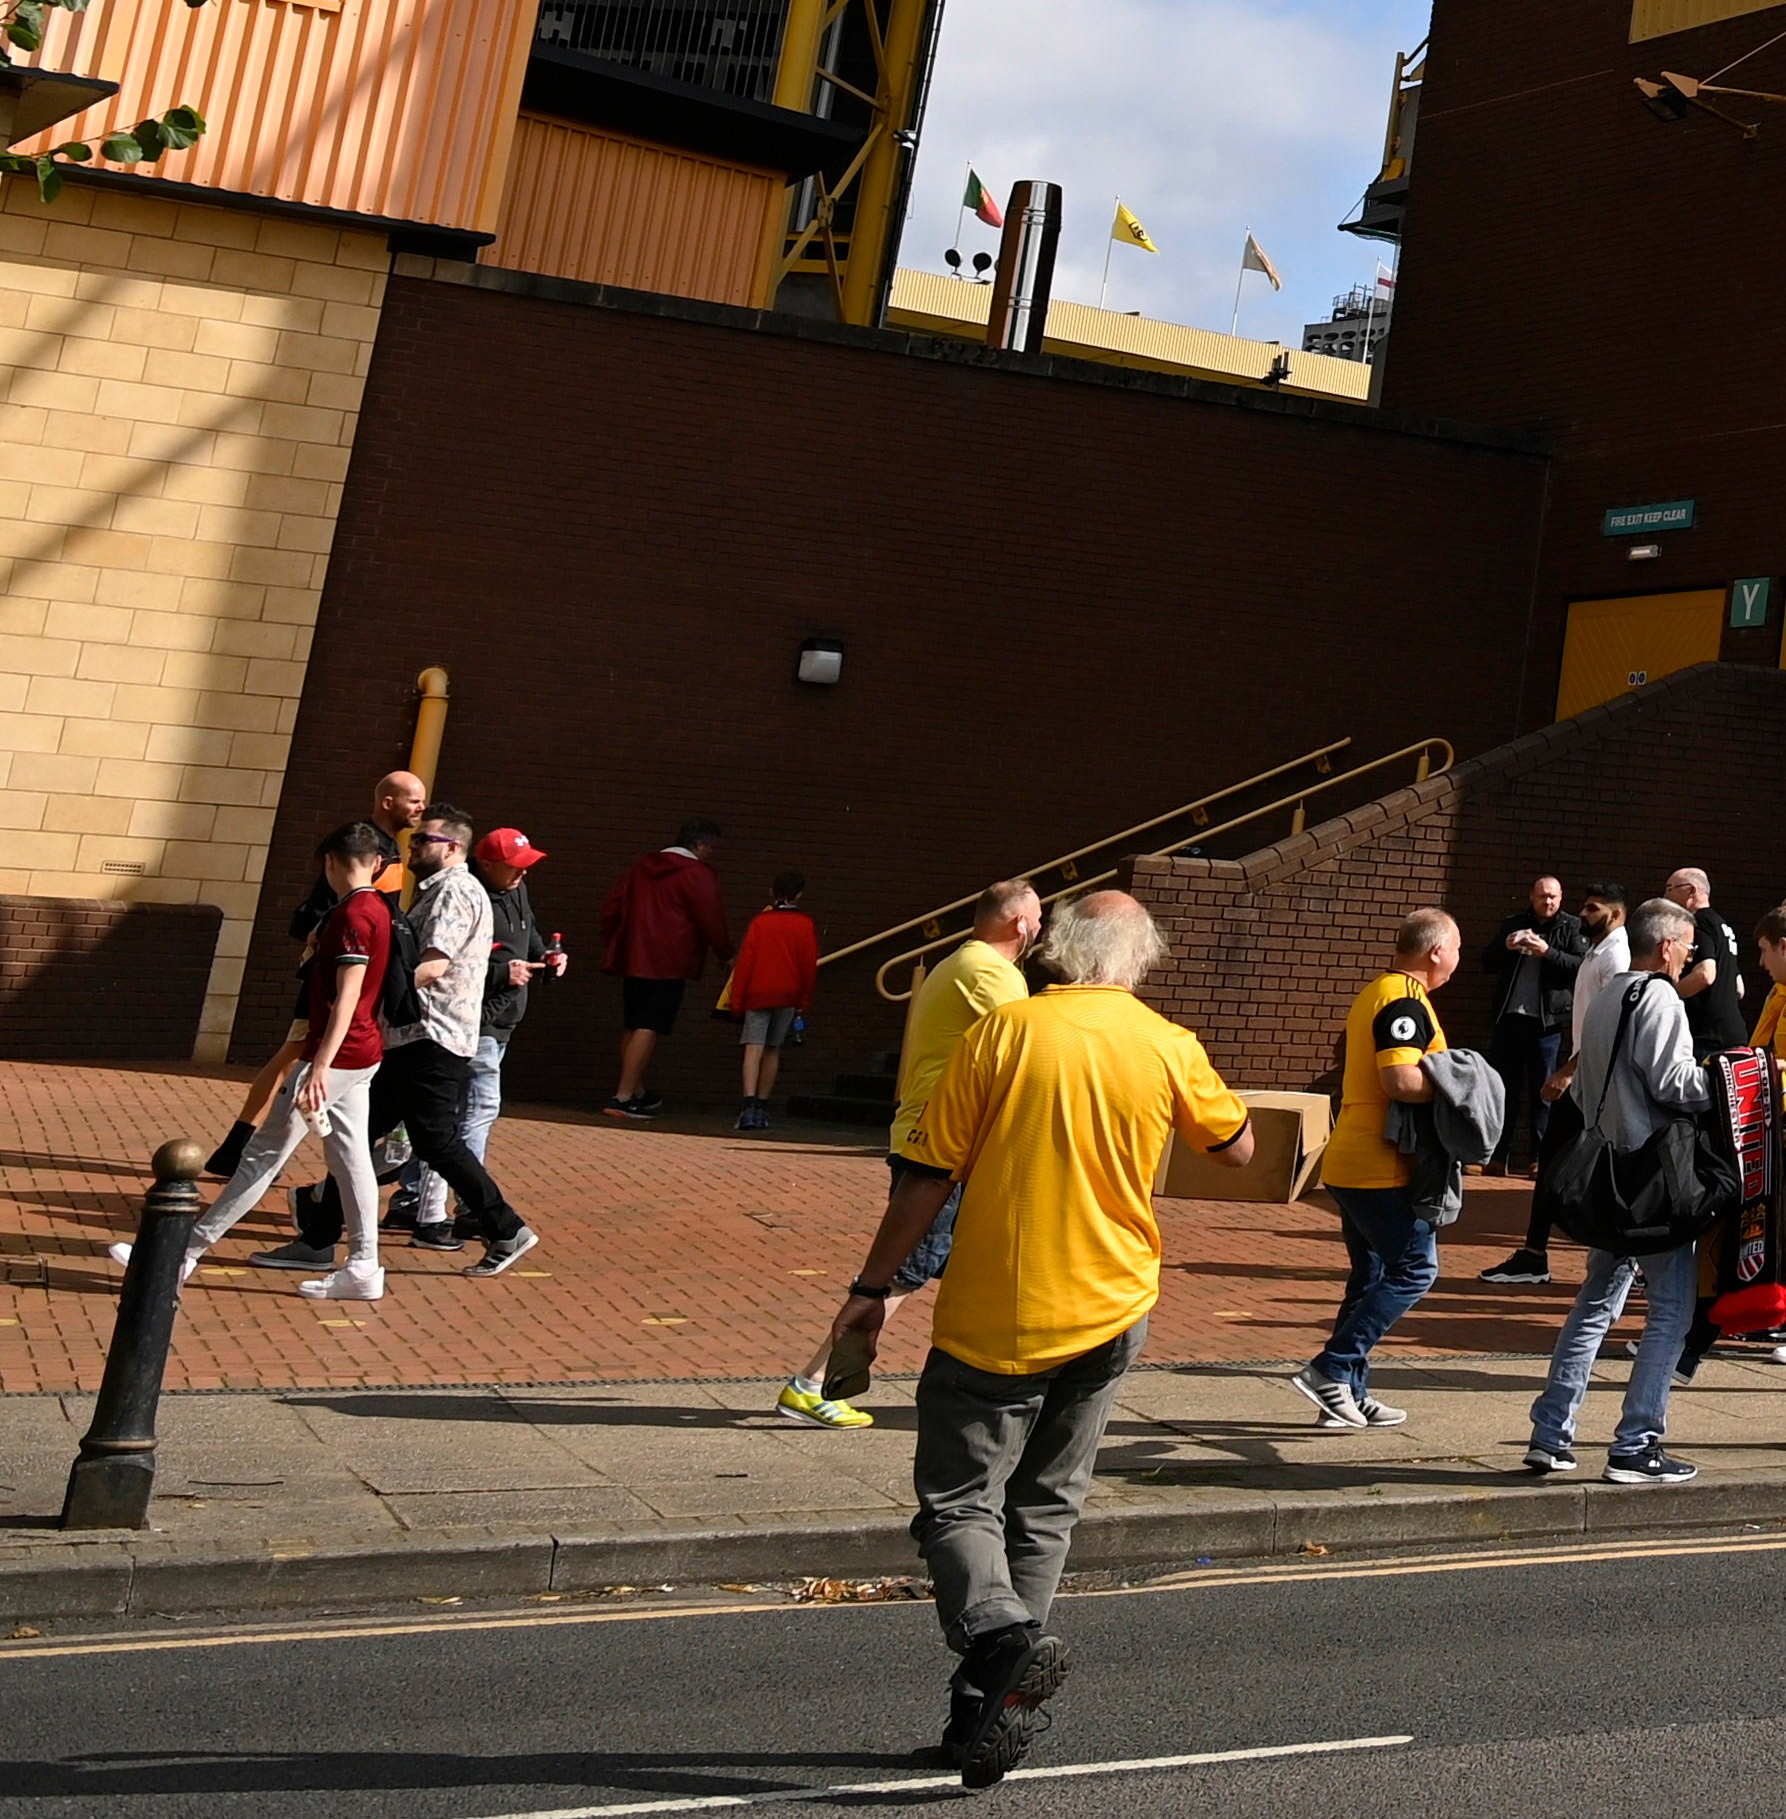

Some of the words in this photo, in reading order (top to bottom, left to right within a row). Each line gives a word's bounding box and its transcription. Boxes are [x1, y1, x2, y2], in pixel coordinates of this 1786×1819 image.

[1610, 514, 1626, 527] FIRE
[1627, 513, 1643, 526] EXIT
[1643, 511, 1663, 525] KEEP
[1663, 508, 1686, 523] CLEAR
[1741, 583, 1761, 621] Y
[1731, 1056, 1764, 1201] UNITED
